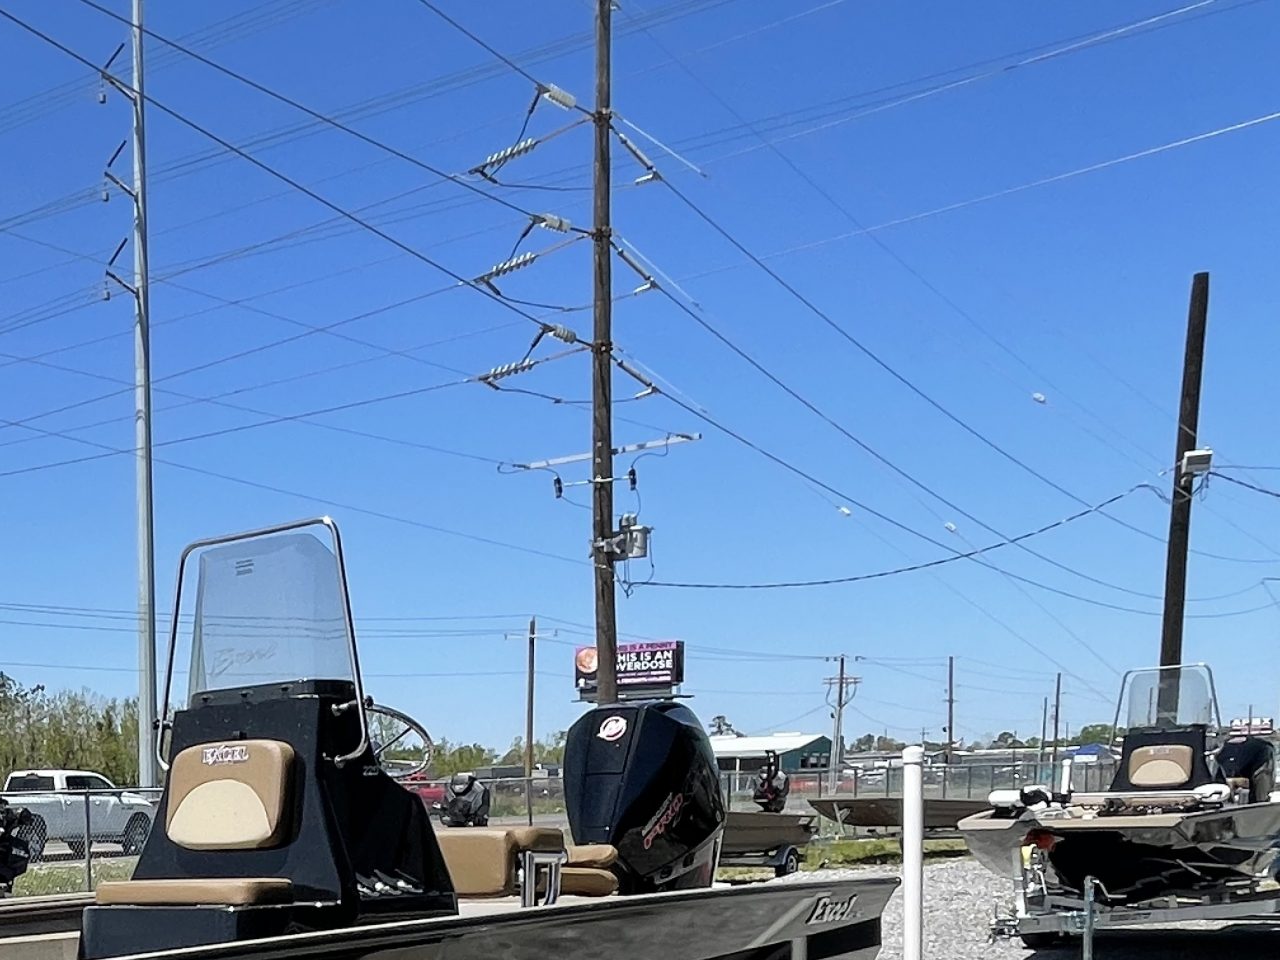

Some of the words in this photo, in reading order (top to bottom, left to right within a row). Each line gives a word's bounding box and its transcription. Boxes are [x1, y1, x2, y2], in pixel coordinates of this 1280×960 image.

[616, 652, 638, 662] HIS
[640, 651, 652, 661] IS
[654, 650, 673, 660] AN
